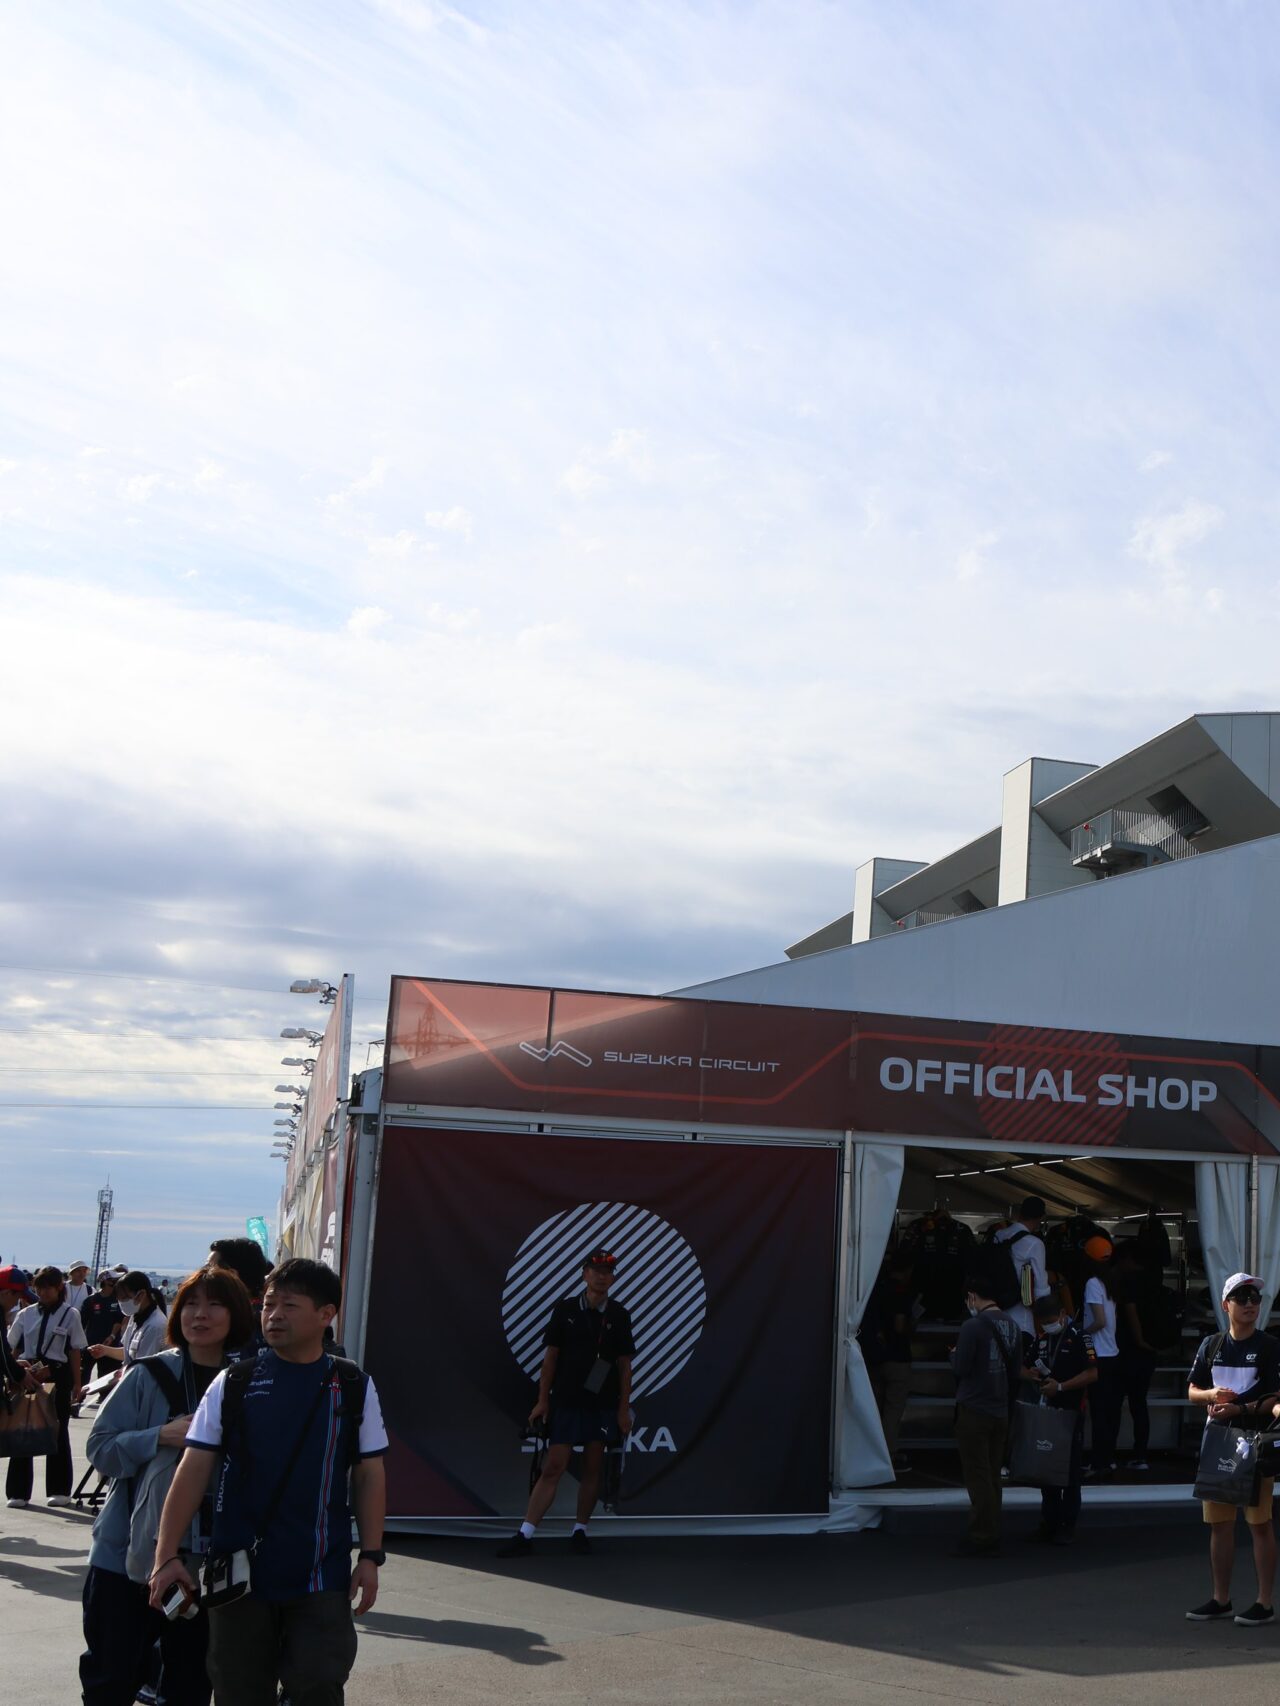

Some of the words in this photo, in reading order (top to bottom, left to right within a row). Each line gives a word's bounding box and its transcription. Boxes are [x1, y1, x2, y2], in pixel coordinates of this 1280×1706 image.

[603, 1051, 694, 1068] SUZUKA
[698, 1057, 781, 1074] CIRCUIT
[879, 1056, 1087, 1104] OFFICIAL
[1097, 1073, 1218, 1112] SHOP
